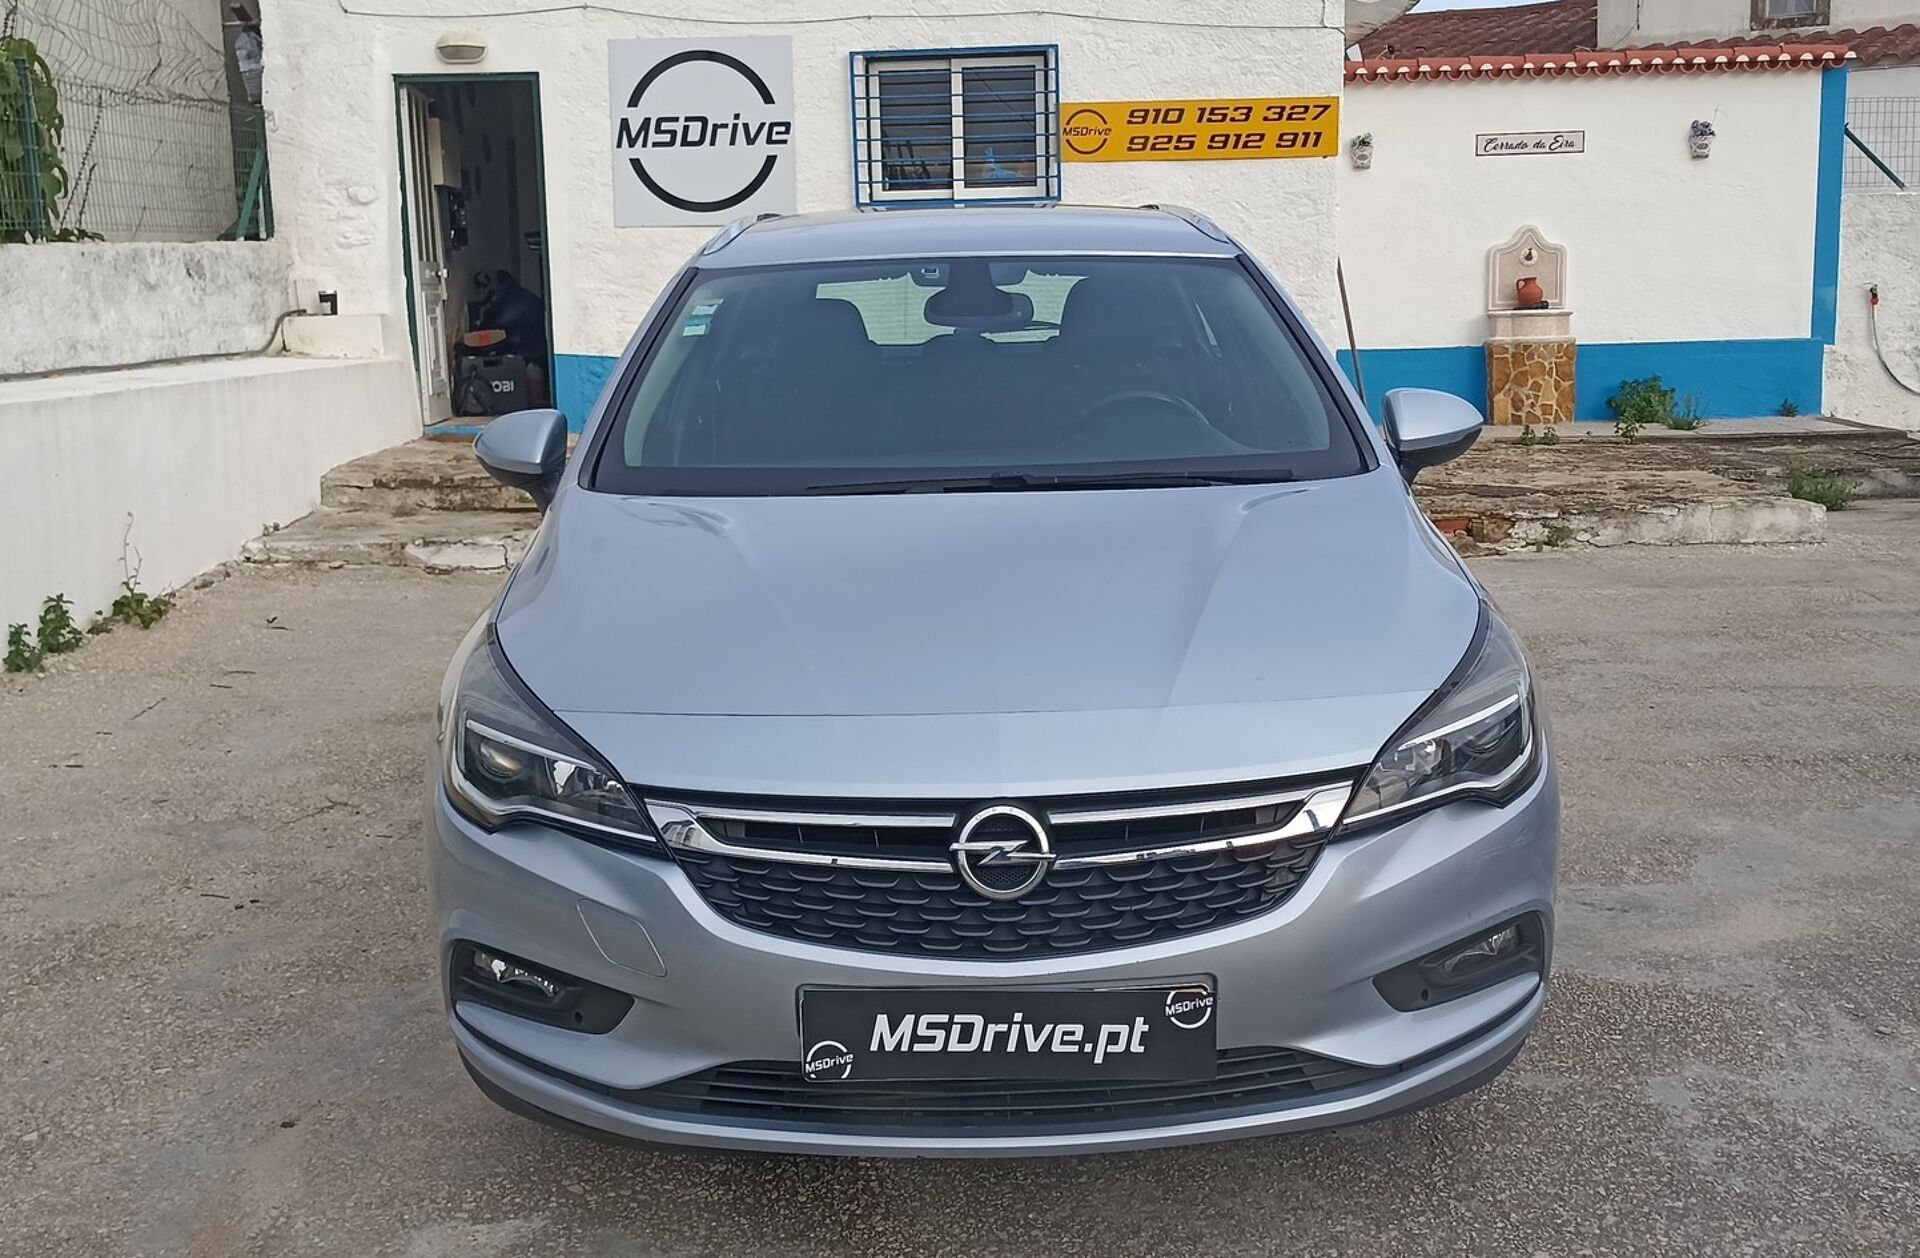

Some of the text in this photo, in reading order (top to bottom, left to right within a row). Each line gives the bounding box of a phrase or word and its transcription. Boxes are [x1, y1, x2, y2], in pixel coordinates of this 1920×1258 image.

[1126, 104, 1331, 125] 910 153 327
[616, 113, 792, 149] MSDrive
[1062, 126, 1112, 137] MSDrive
[1126, 131, 1323, 152] 925 912 911
[1165, 996, 1214, 1017] MSDrive
[869, 1012, 1149, 1064] MSDrive.pt
[805, 1052, 854, 1074] MSDrive
